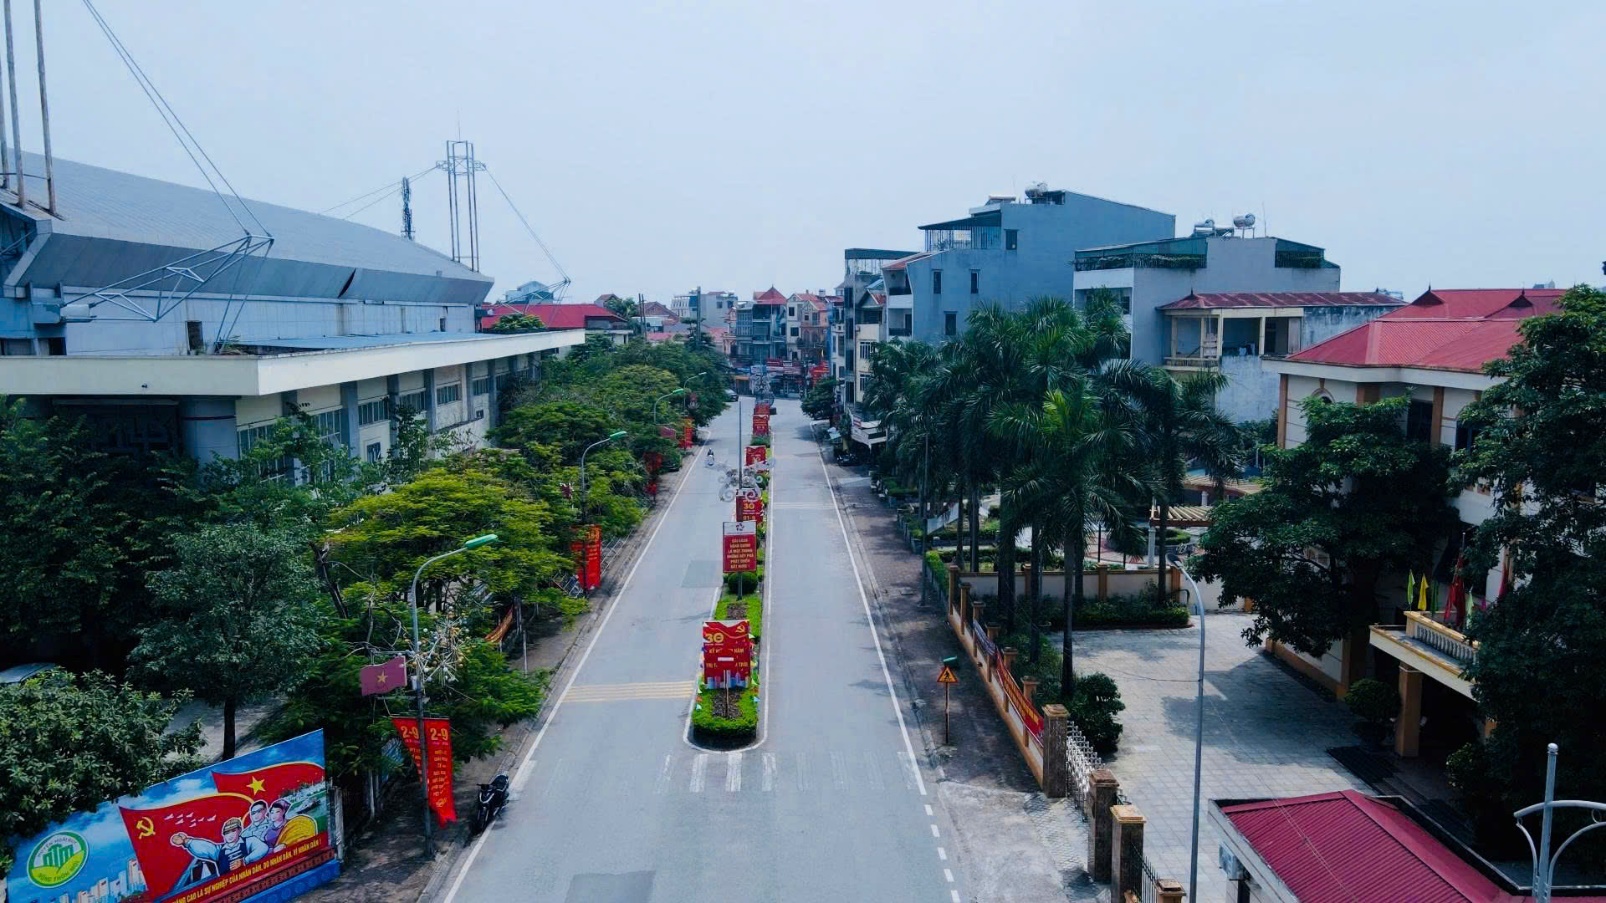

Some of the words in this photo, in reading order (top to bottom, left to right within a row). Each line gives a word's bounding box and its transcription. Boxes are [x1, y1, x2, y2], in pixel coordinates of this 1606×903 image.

[706, 632, 724, 643] 30
[401, 725, 419, 739] 2-9
[430, 727, 448, 741] 2-9
[187, 893, 196, 902] CAO
[197, 889, 203, 898] LÀ
[204, 885, 212, 895] SỰ
[212, 878, 228, 892] NGHIỆP
[229, 873, 239, 884] CỦA
[239, 868, 251, 880] NHÂN
[263, 860, 269, 869] DO
[270, 854, 282, 866] NHÂN
[293, 847, 298, 855] VÌ
[298, 844, 309, 853] NHÂN
[309, 839, 318, 847] DÂN
